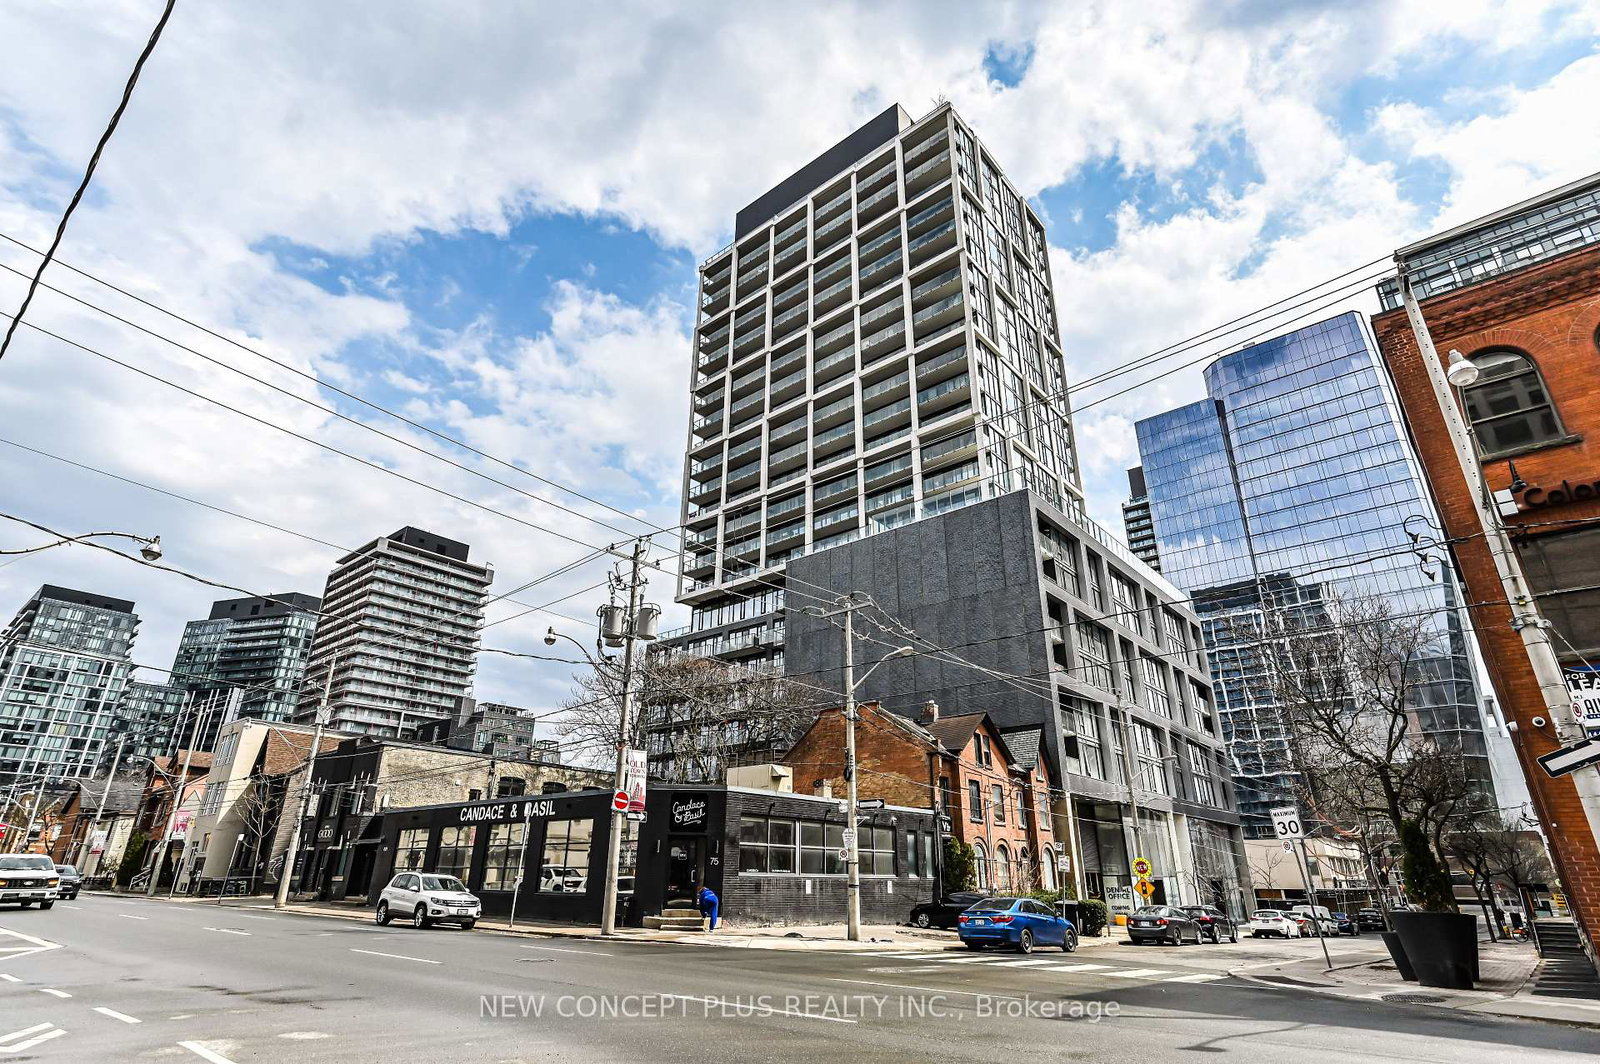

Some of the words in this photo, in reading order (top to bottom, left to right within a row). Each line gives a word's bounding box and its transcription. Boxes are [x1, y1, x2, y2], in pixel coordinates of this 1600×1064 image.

[460, 805, 505, 821] CANDACE
[510, 803, 518, 818] &
[673, 799, 706, 814] Candace
[1277, 820, 1299, 835] 30
[710, 857, 719, 865] 75
